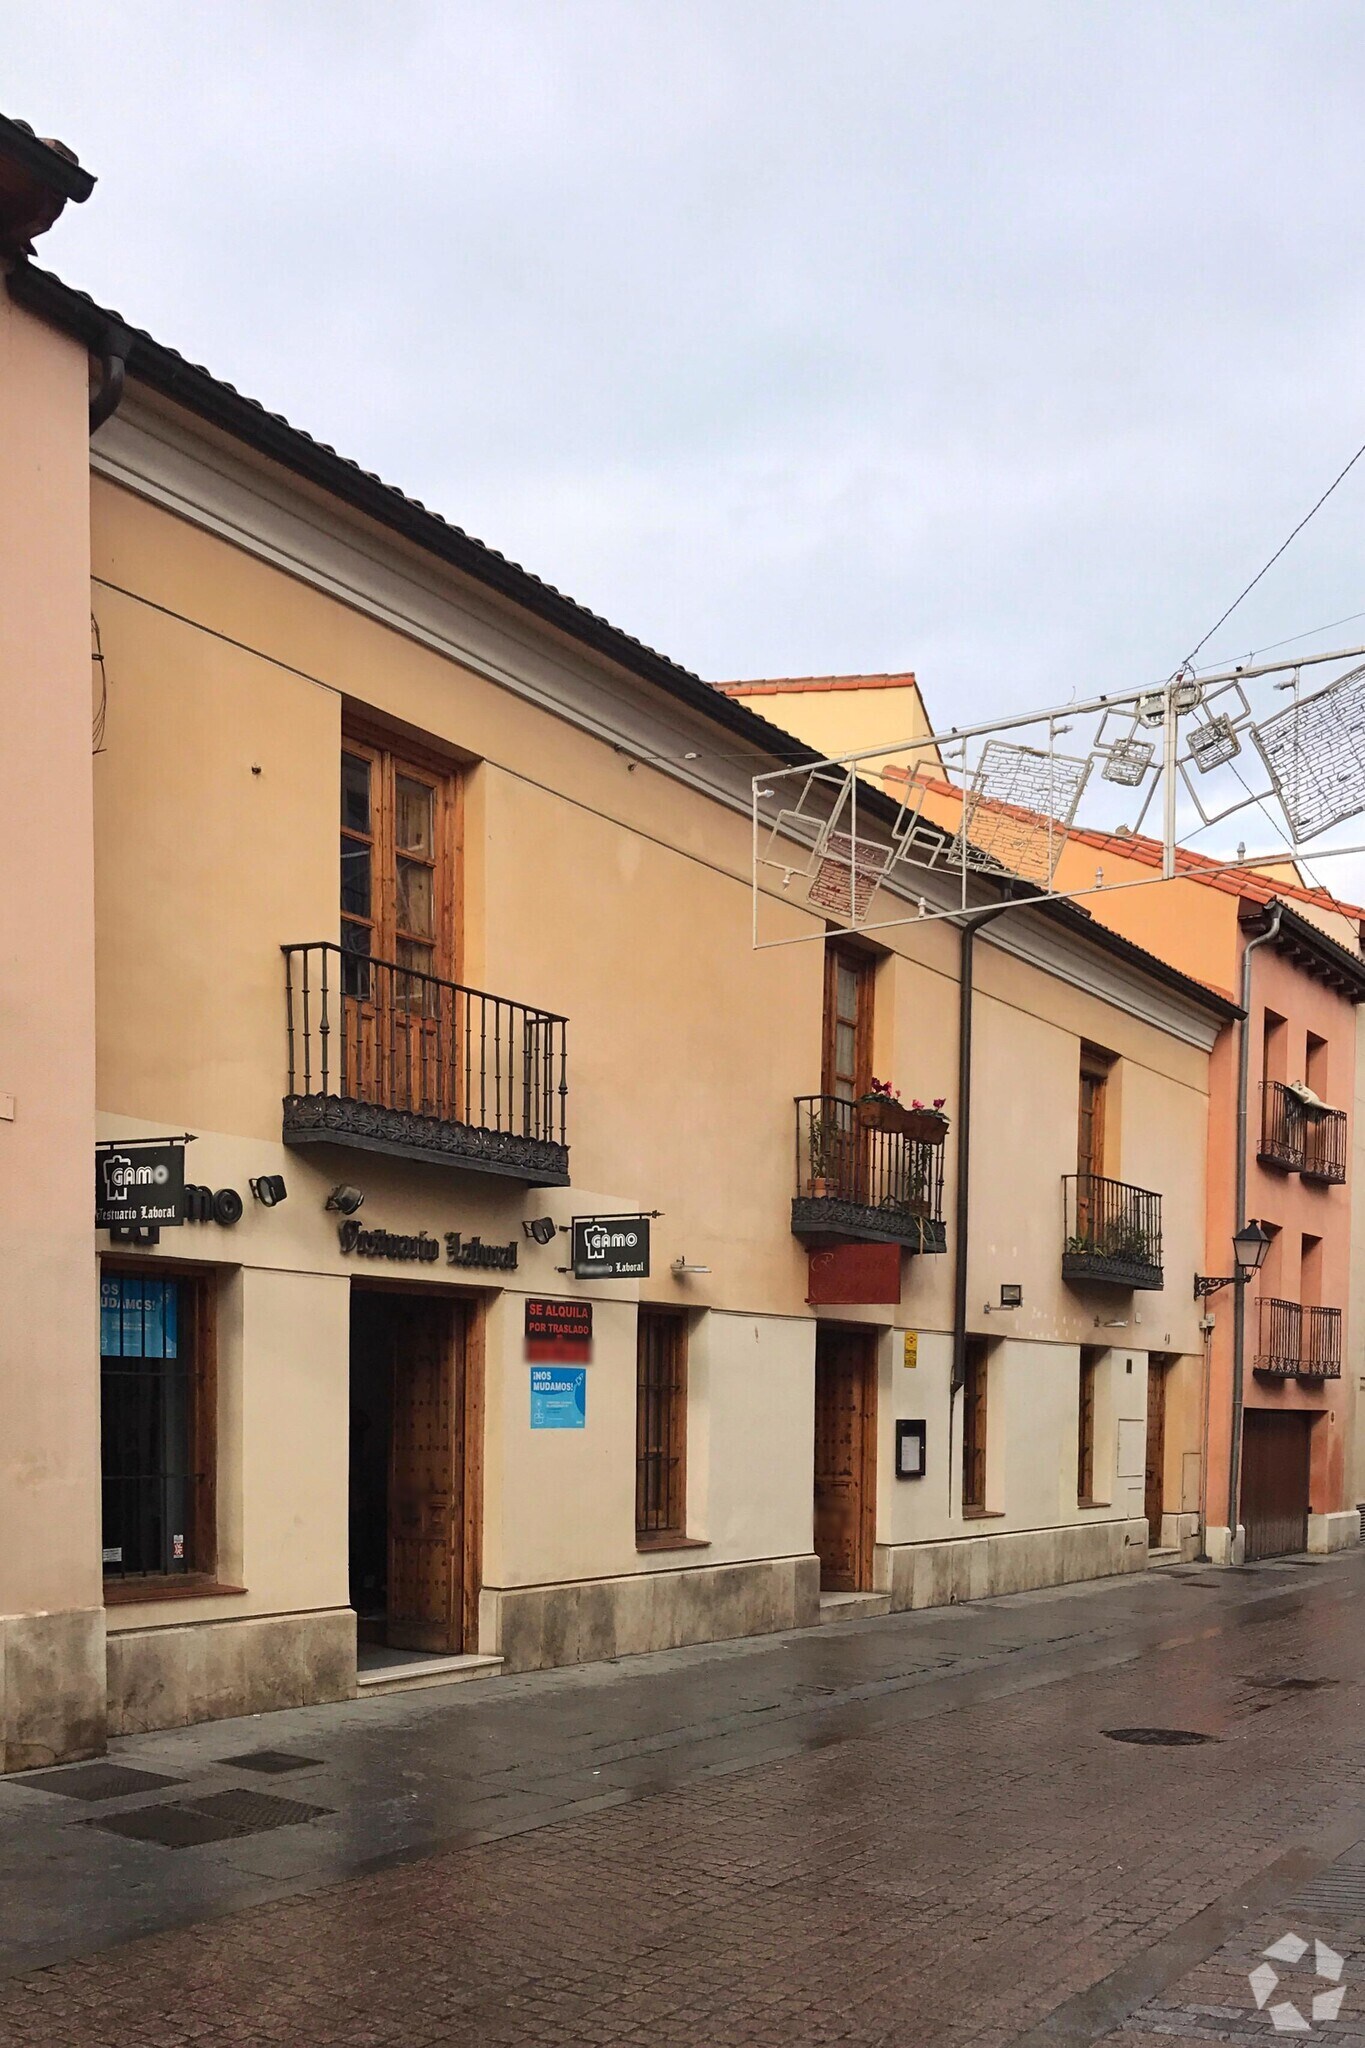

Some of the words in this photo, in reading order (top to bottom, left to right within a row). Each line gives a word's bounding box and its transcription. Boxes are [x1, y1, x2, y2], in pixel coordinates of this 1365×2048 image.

[140, 1205, 176, 1219] Laboral
[591, 1232, 638, 1248] GAMO
[615, 1261, 644, 1273] Laboral
[101, 1296, 156, 1311] UDAMOS!
[529, 1303, 543, 1316] SE
[545, 1304, 589, 1318] ALQUILA
[529, 1322, 546, 1332] POR
[548, 1323, 590, 1335] TRASLADO
[533, 1381, 574, 1392] MUDAMOS!
